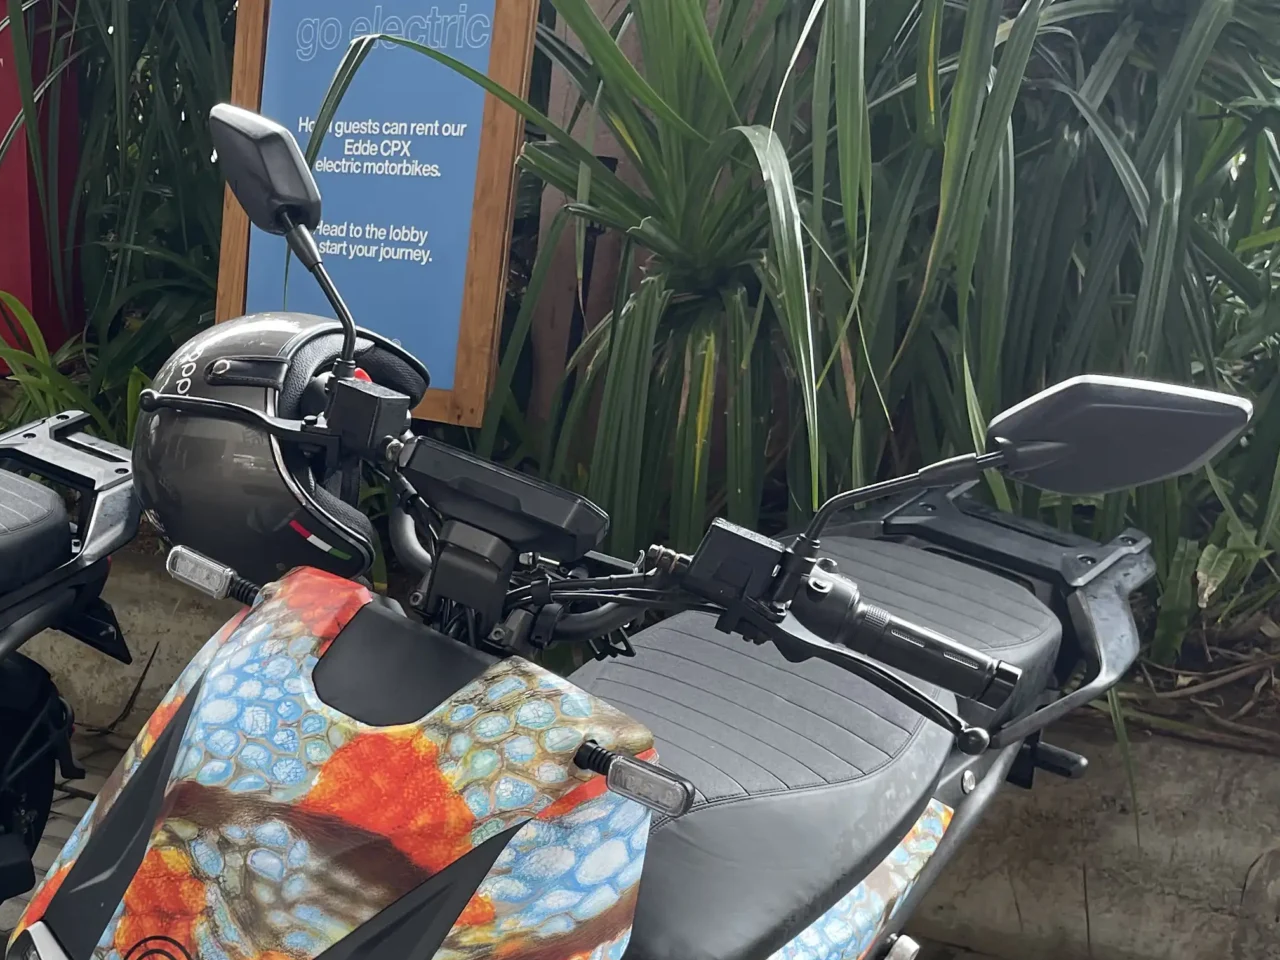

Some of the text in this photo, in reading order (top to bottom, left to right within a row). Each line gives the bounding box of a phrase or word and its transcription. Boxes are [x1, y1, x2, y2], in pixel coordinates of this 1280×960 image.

[296, 4, 490, 61] go electric
[334, 119, 380, 137] guests
[382, 122, 407, 136] can
[410, 120, 439, 136] rent
[442, 123, 467, 137] our
[344, 139, 411, 157] Edde CPX
[315, 157, 441, 177] electric motorbikes.
[349, 222, 363, 238] to
[365, 224, 386, 239] the
[389, 225, 428, 246] lobby
[319, 240, 433, 265] start your journey.
